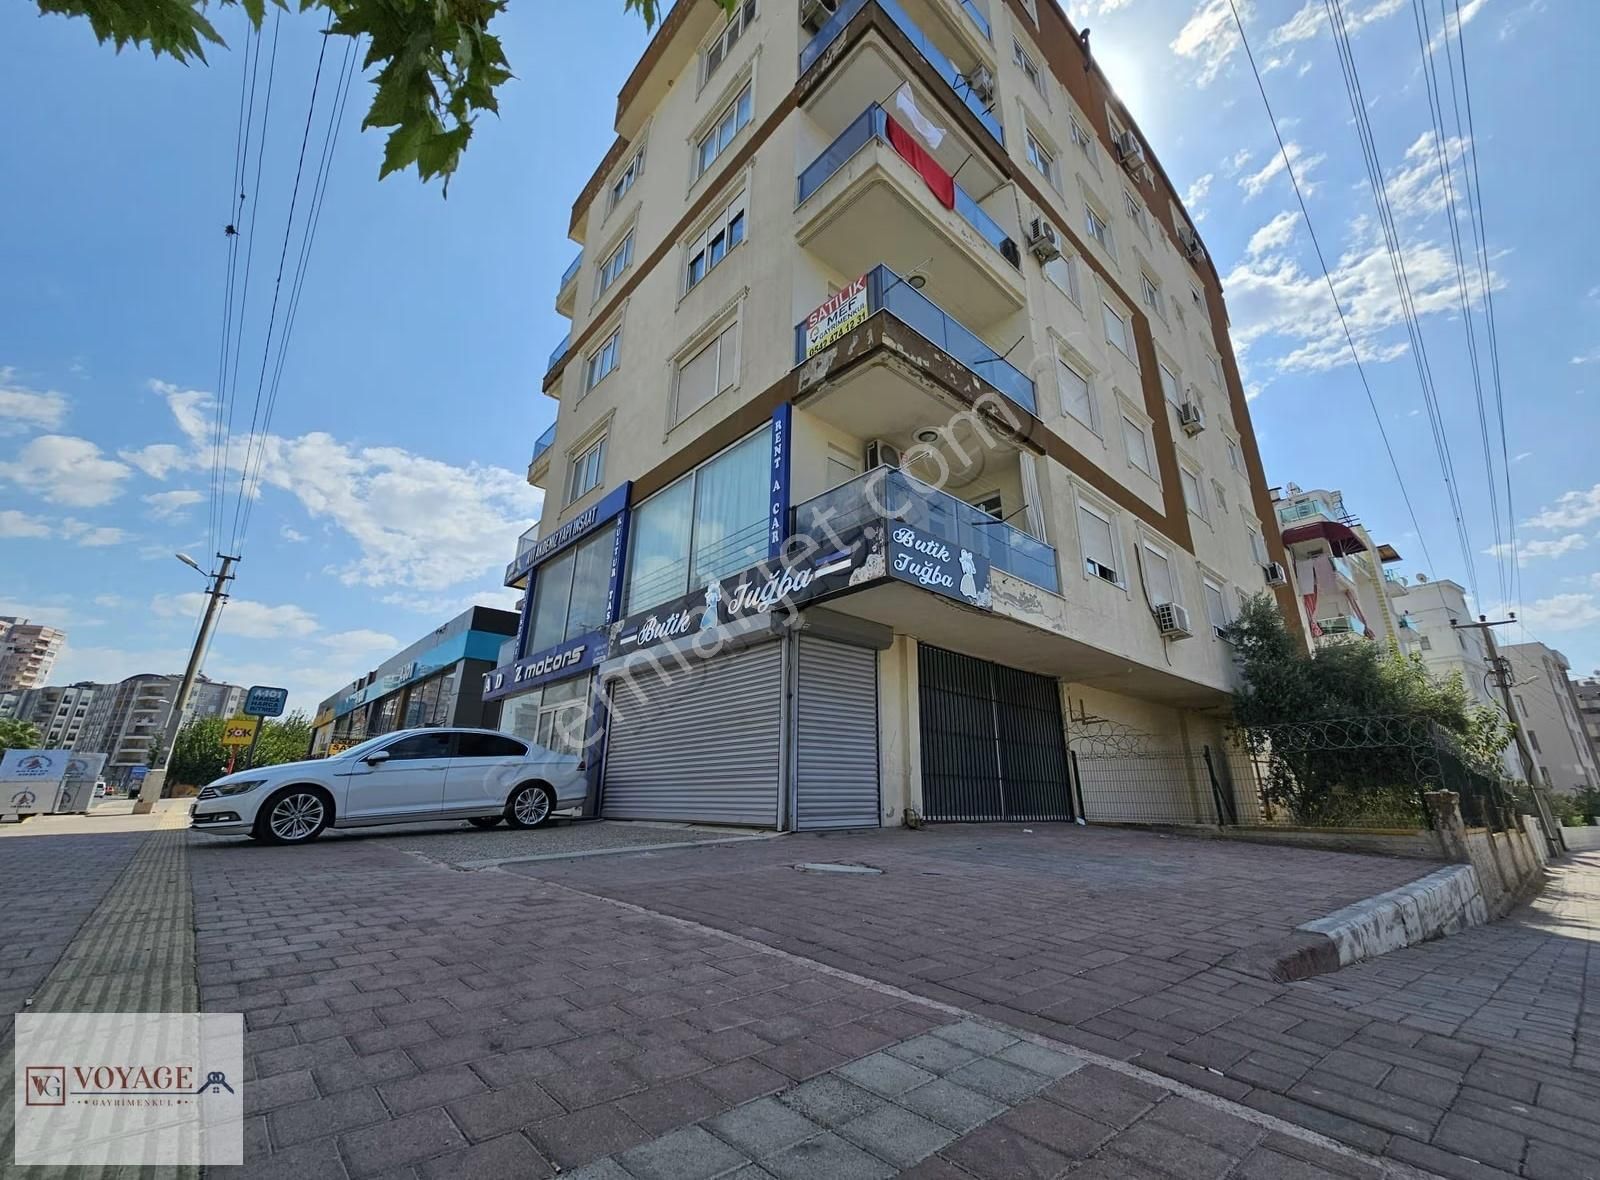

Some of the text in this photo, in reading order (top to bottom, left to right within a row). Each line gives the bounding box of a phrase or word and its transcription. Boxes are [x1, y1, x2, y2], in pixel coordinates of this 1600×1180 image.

[809, 275, 865, 328] SATILIK
[827, 296, 857, 326] MEF
[772, 420, 782, 543] RENT A CAR
[893, 528, 951, 563] Butik
[894, 553, 953, 588] Tuğba
[637, 566, 813, 645] Butik Tuğba
[524, 645, 586, 680] motors
